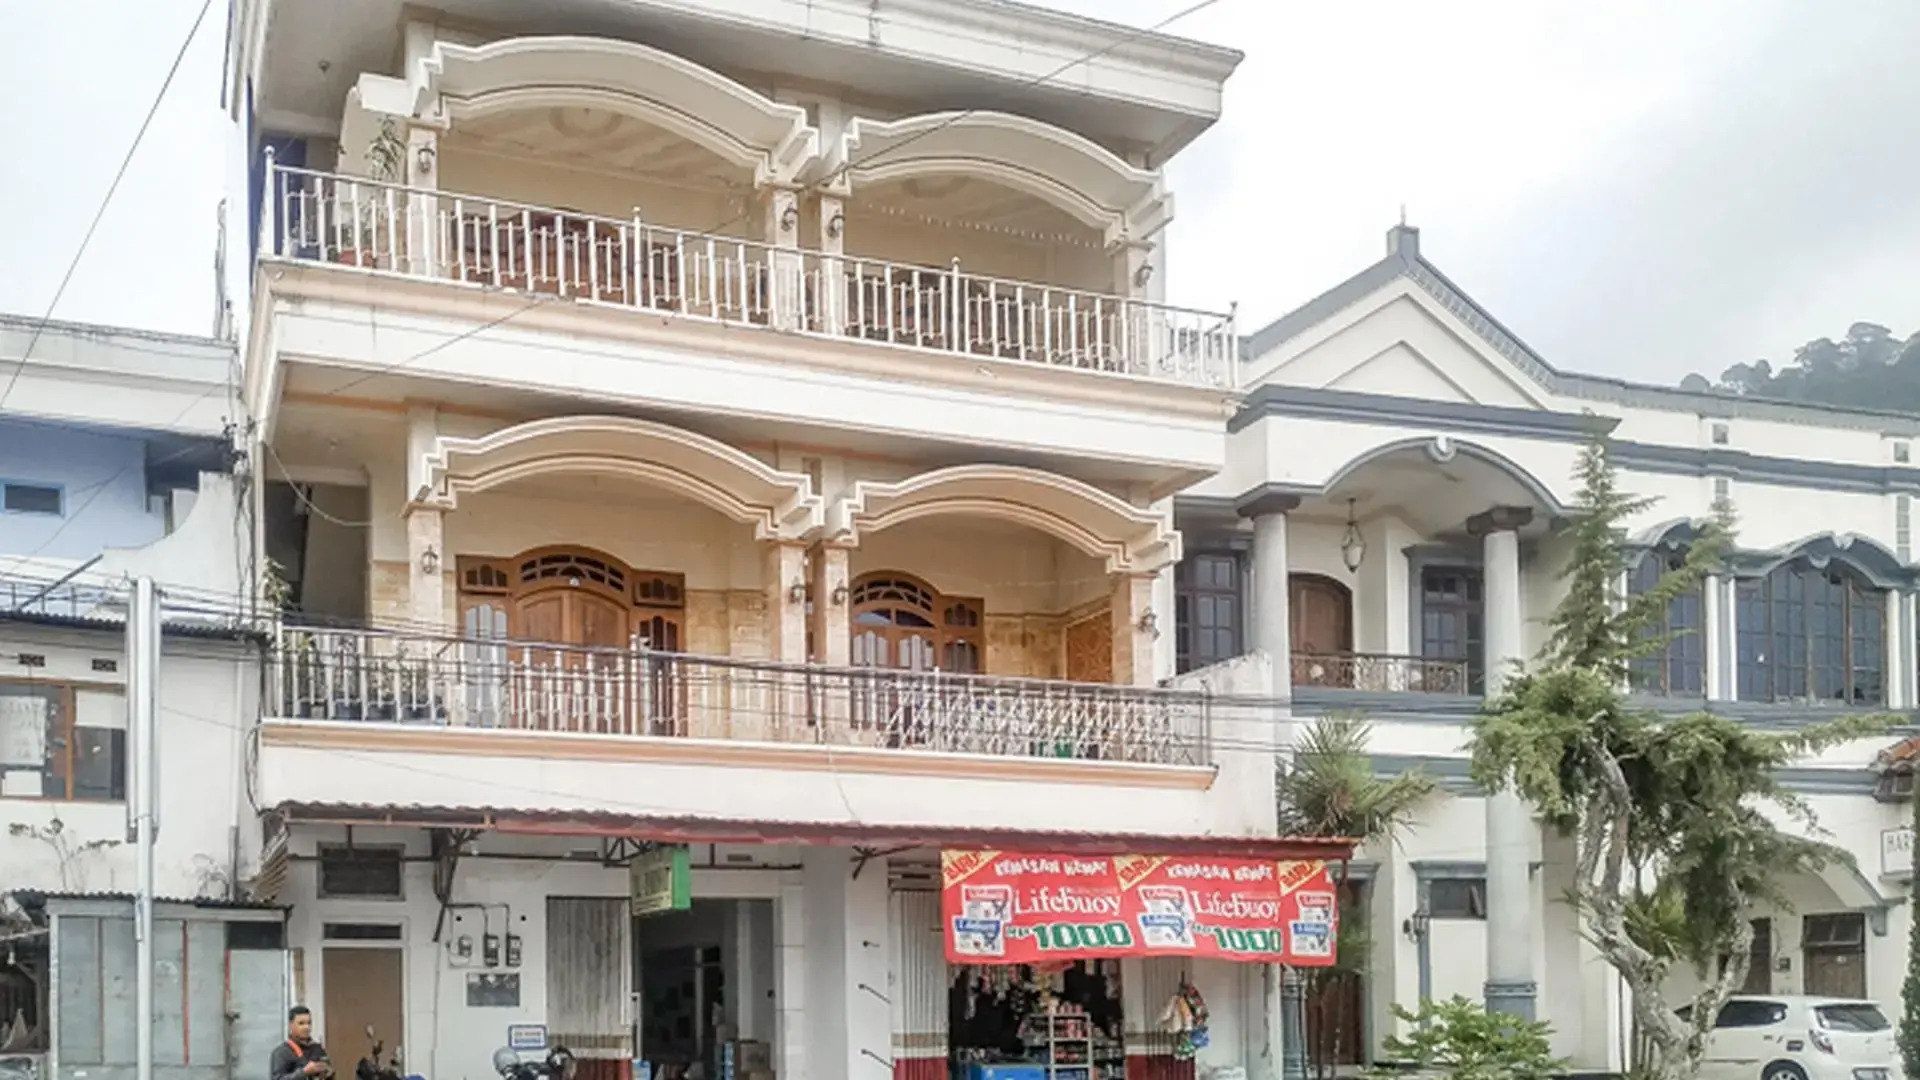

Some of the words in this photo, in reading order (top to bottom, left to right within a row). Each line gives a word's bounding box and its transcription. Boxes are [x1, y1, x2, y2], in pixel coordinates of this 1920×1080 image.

[1015, 887, 1121, 916] Lifebuoy
[1190, 890, 1280, 922] Lifebuoy
[1034, 922, 1133, 949] 1000
